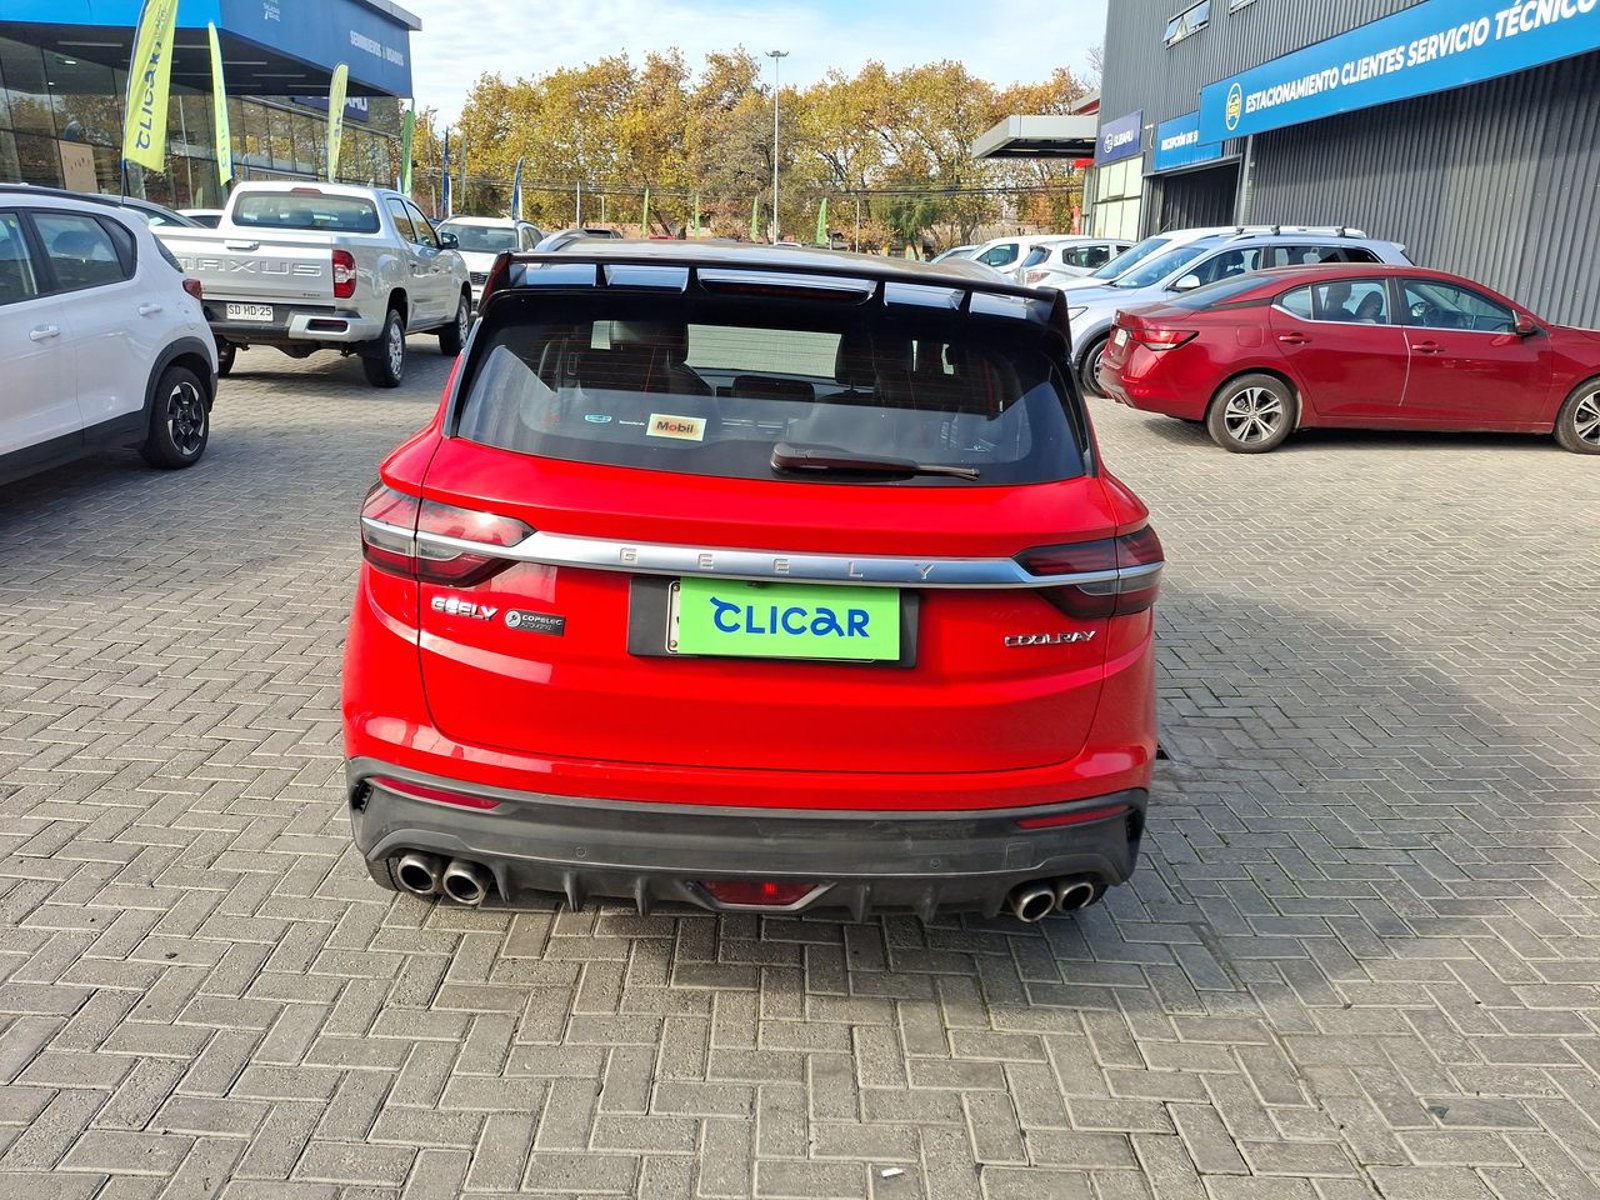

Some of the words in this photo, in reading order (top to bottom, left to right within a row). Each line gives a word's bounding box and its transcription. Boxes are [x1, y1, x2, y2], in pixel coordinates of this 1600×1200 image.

[1245, 66, 1340, 114] ESTACIONAMIENTO
[1341, 45, 1405, 86] CLIENTES
[1406, 16, 1490, 67] SERVICIO
[1495, 0, 1598, 41] TÉCNICO
[228, 304, 241, 315] SD
[656, 421, 694, 434] Mobil
[431, 596, 498, 621] GEELY
[1004, 630, 1097, 647] COOLRAY
